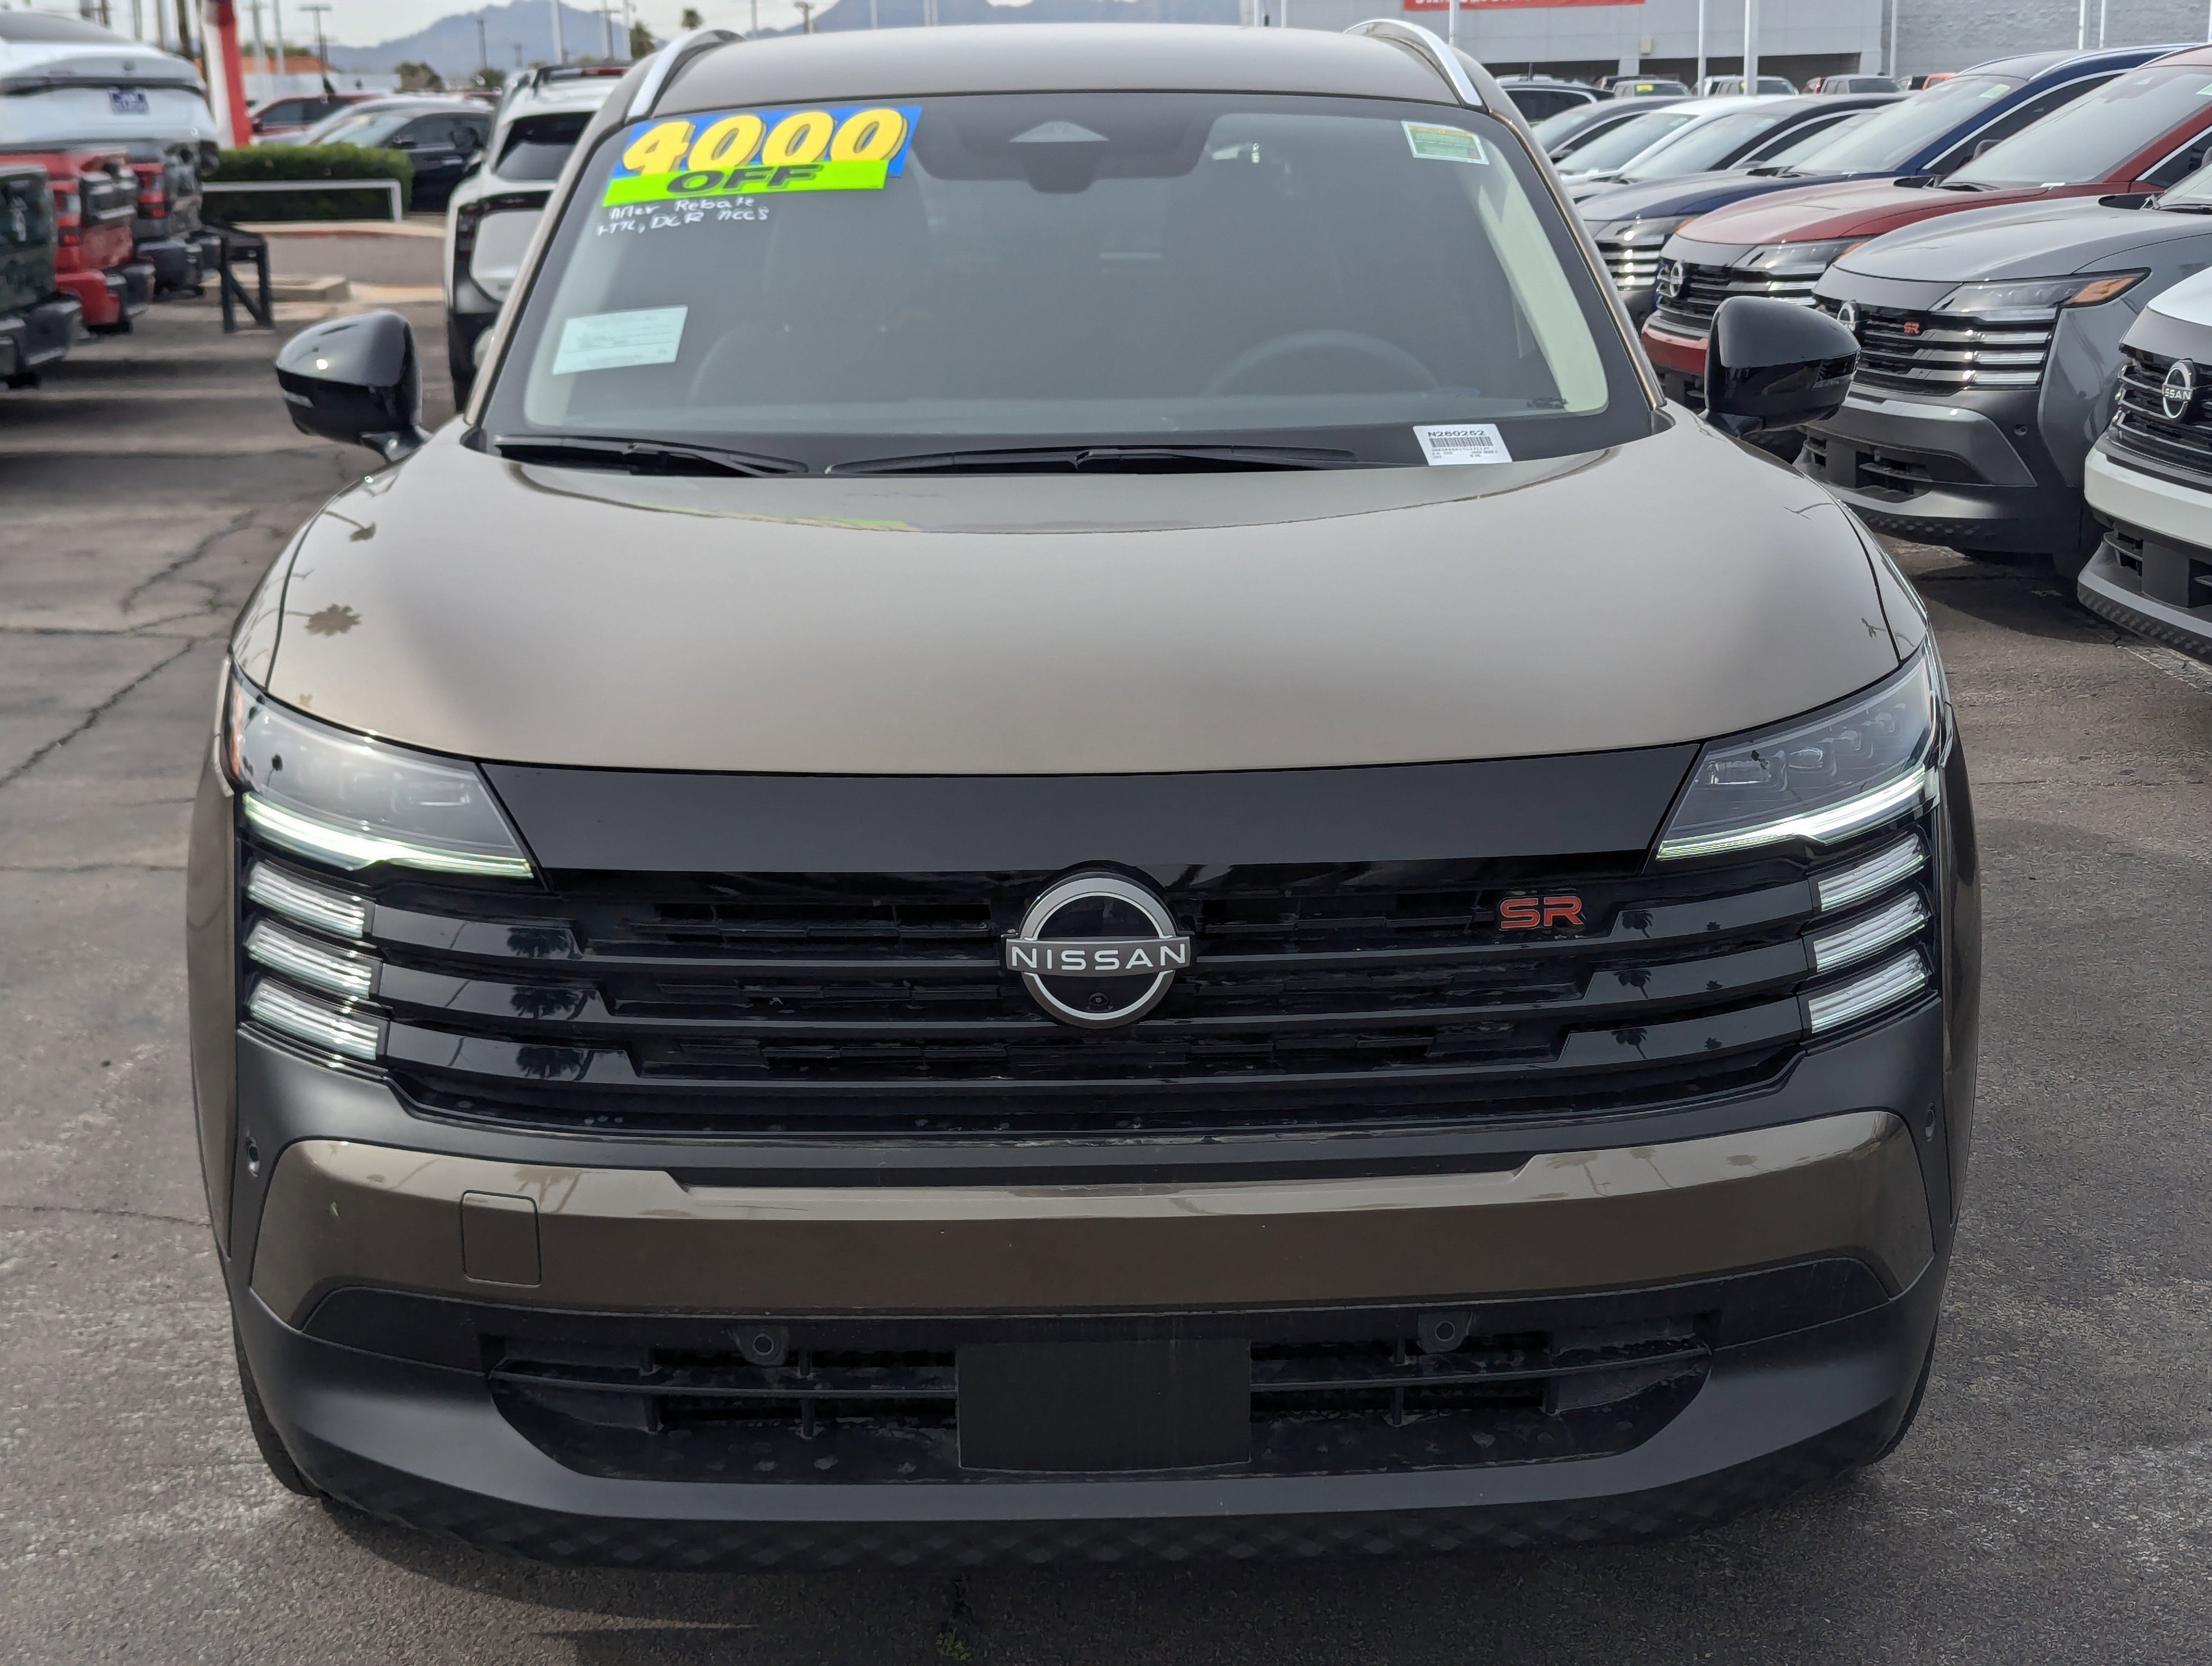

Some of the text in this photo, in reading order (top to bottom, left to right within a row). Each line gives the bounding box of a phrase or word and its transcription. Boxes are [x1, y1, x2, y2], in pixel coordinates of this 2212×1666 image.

[622, 108, 908, 175] 4000
[667, 164, 824, 194] OFF
[1903, 322, 1920, 334] SR
[1500, 895, 1584, 929] SR
[1011, 943, 1186, 971] NISSAN
